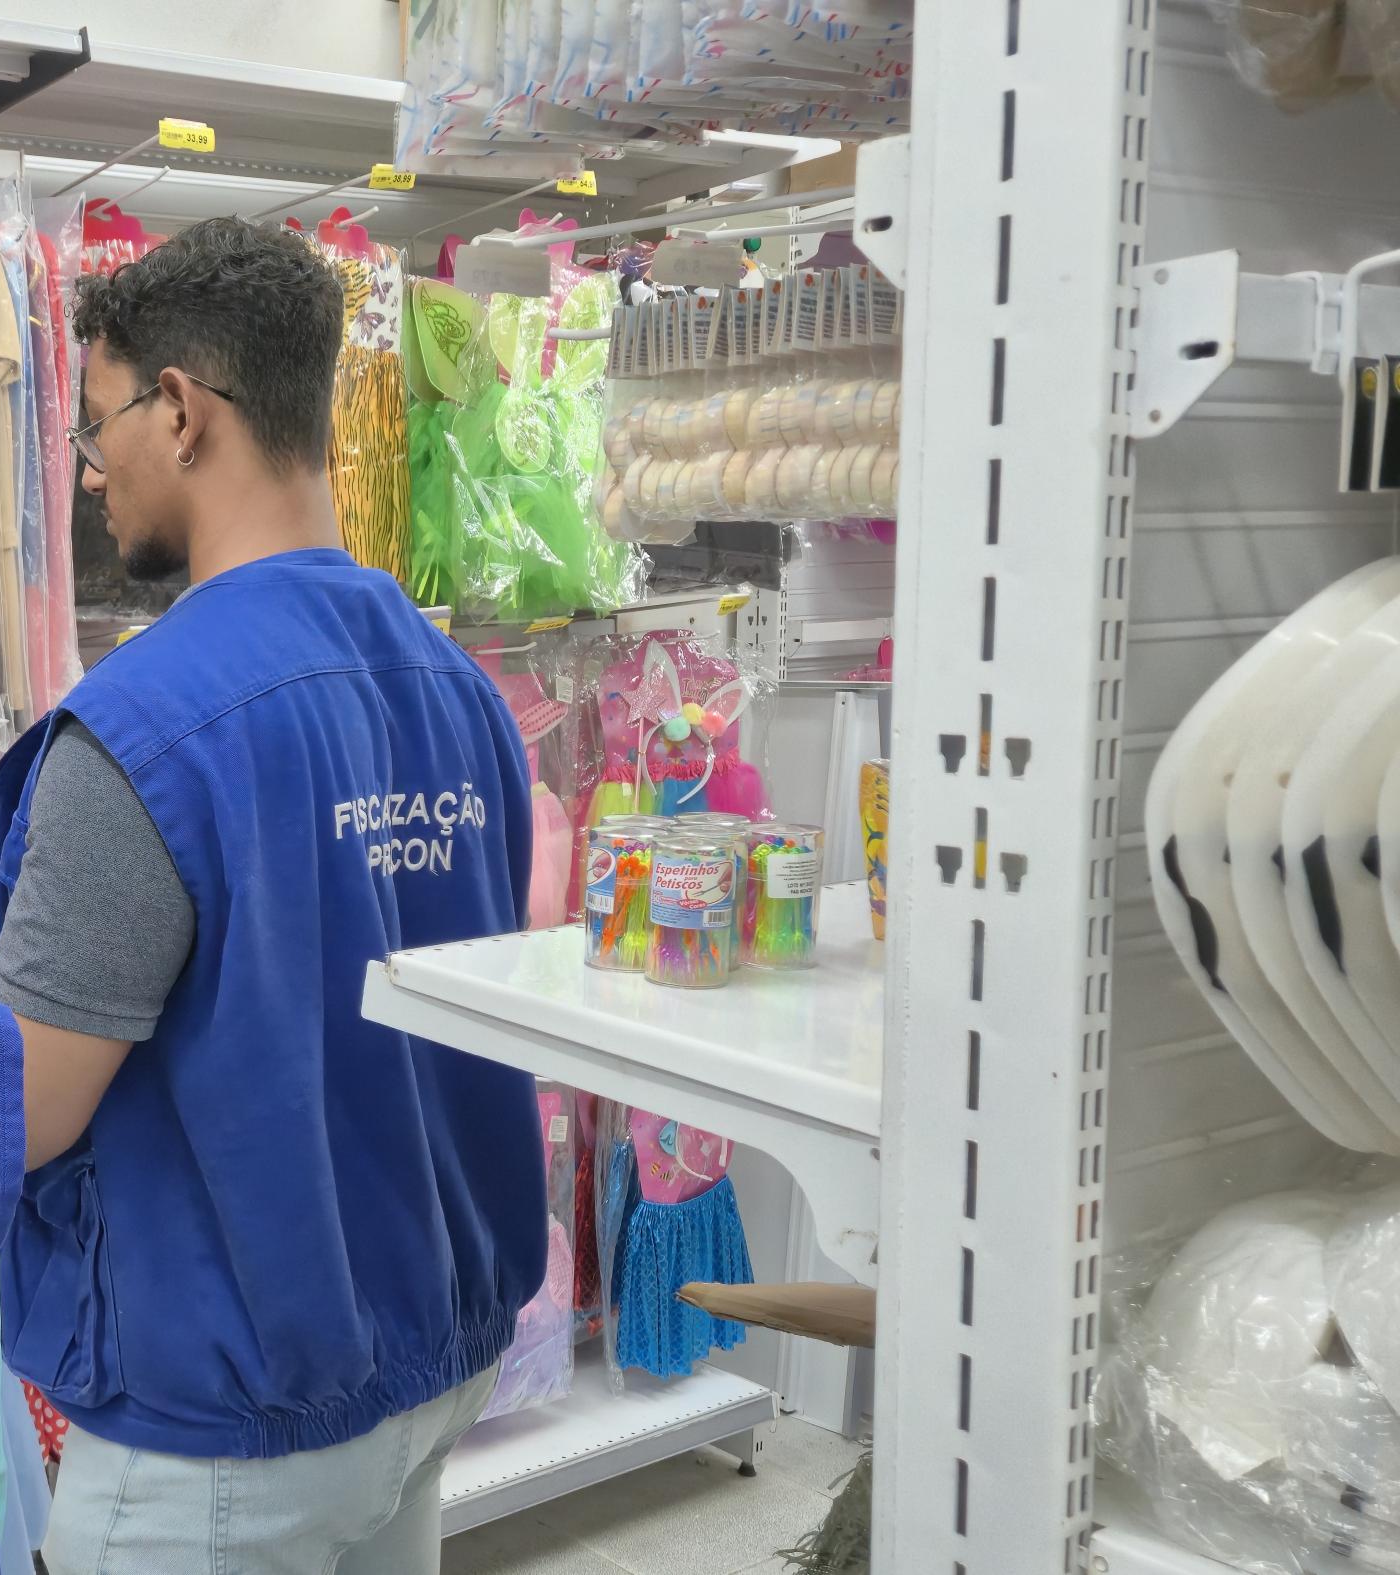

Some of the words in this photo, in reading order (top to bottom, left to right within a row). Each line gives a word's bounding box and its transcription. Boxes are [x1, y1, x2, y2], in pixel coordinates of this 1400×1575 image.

[186, 133, 208, 145] 33,99
[655, 862, 720, 877] Espetinhos
[654, 876, 704, 890] Petiscos
